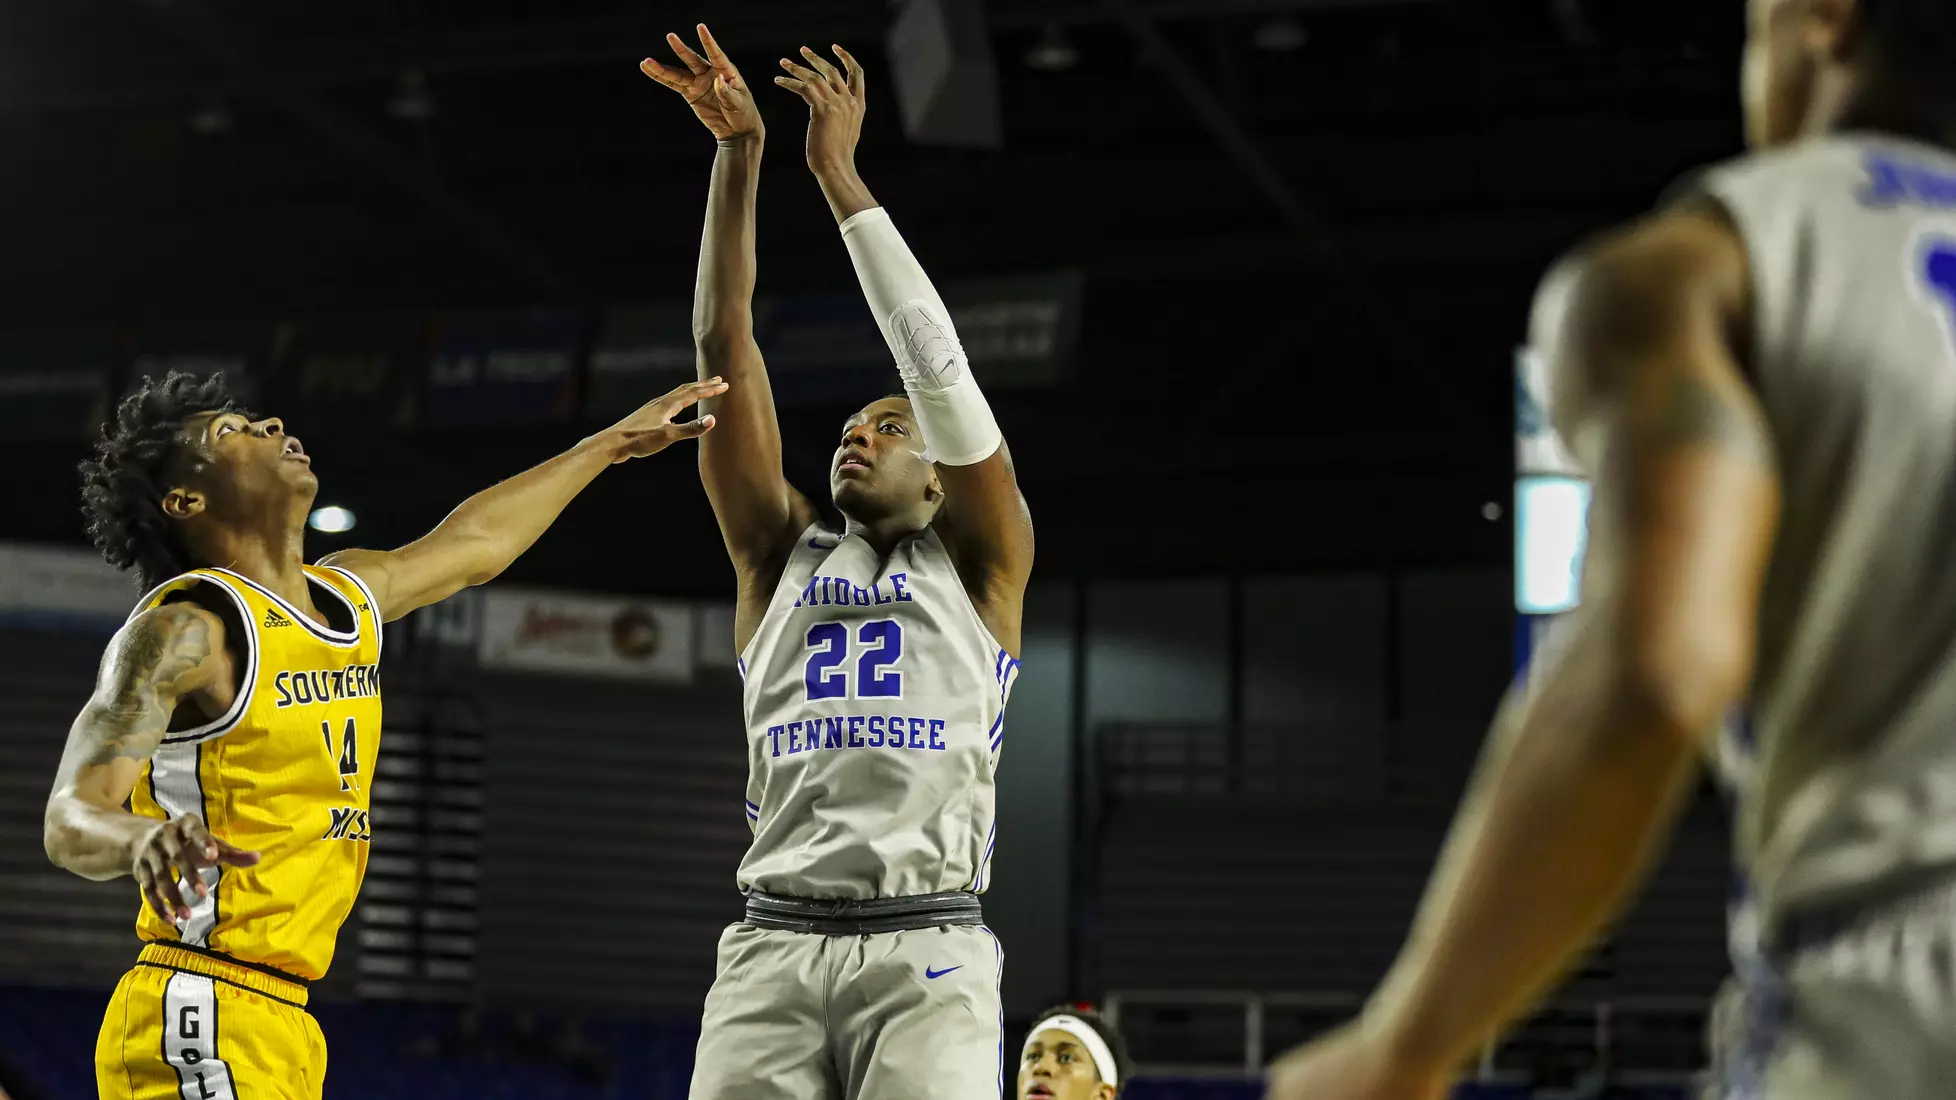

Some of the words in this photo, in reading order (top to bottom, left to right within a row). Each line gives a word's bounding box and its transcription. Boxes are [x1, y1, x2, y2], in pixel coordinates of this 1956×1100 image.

[263, 620, 292, 628] adidas
[803, 617, 904, 704] 22
[766, 714, 947, 758] TENNESSEE
